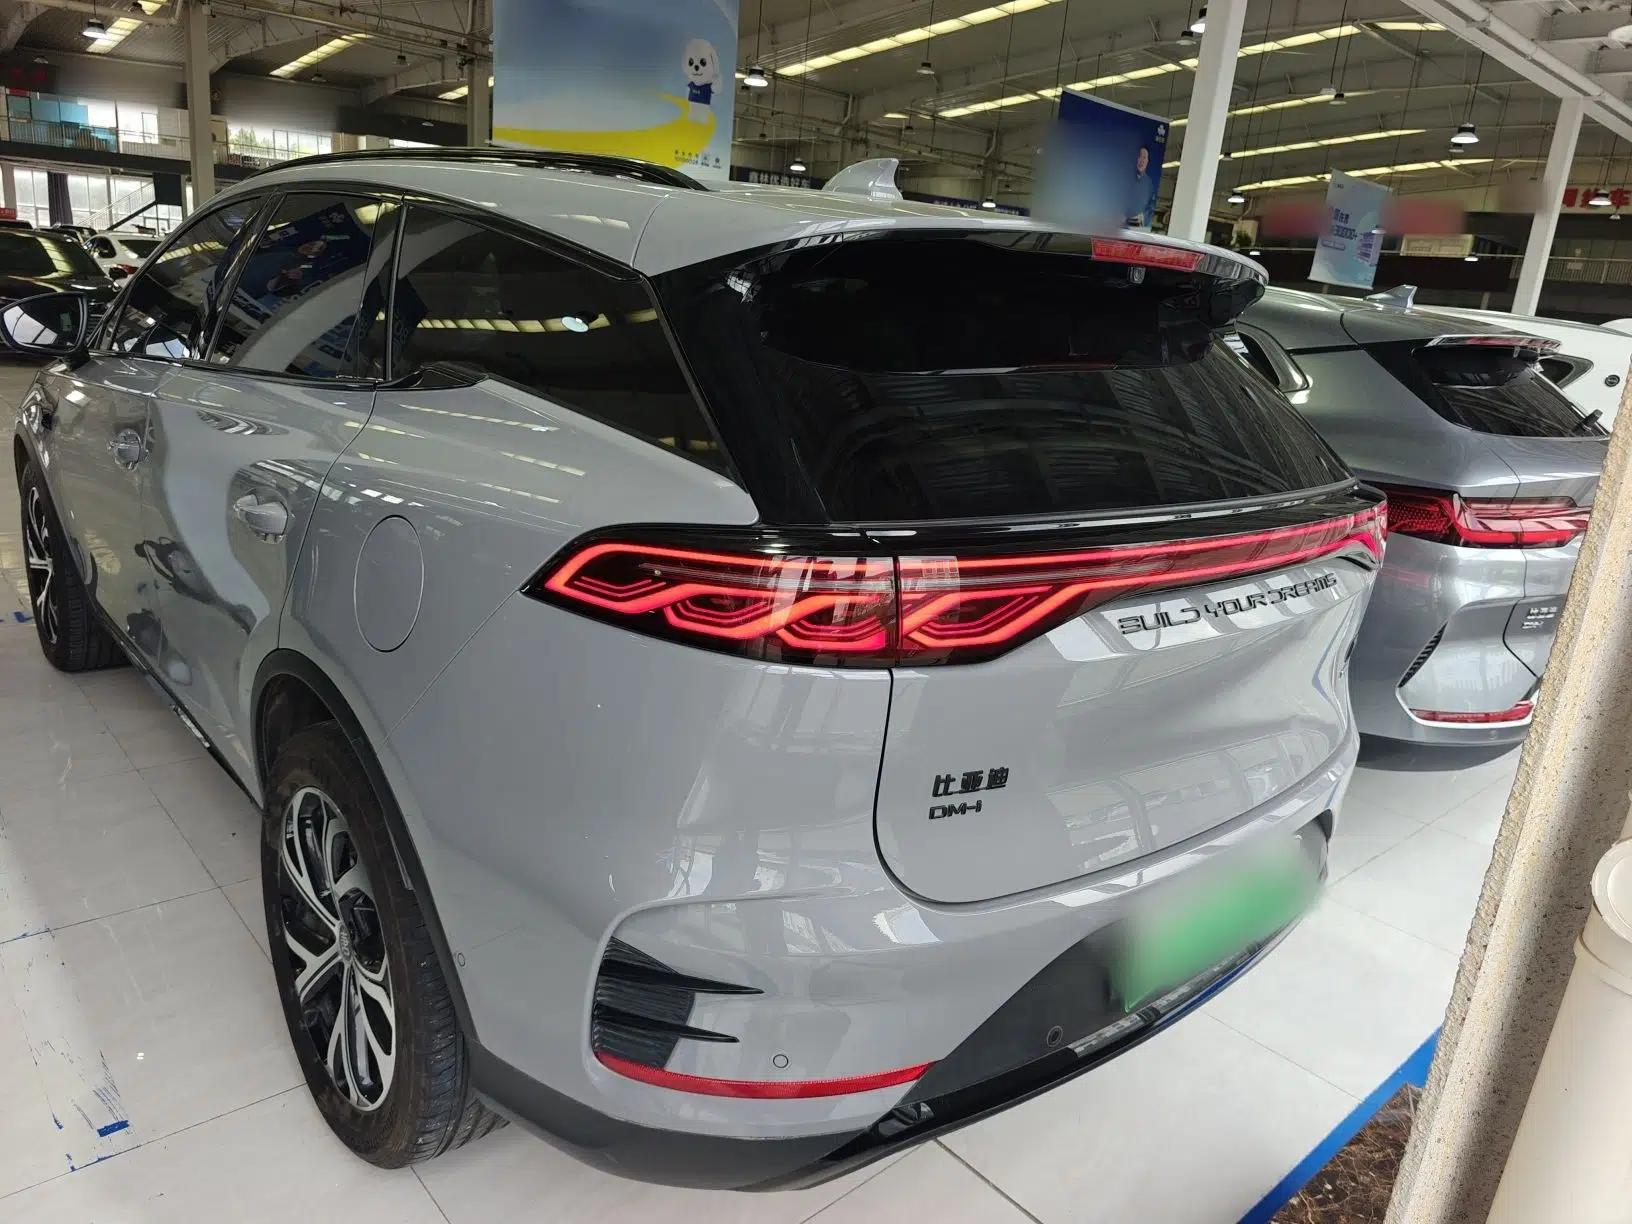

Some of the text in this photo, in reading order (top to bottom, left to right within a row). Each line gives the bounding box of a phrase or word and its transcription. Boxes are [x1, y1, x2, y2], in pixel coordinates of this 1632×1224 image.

[1118, 572, 1338, 635] BUILD YOUR DREAMS
[932, 766, 1010, 798] 比亚迪
